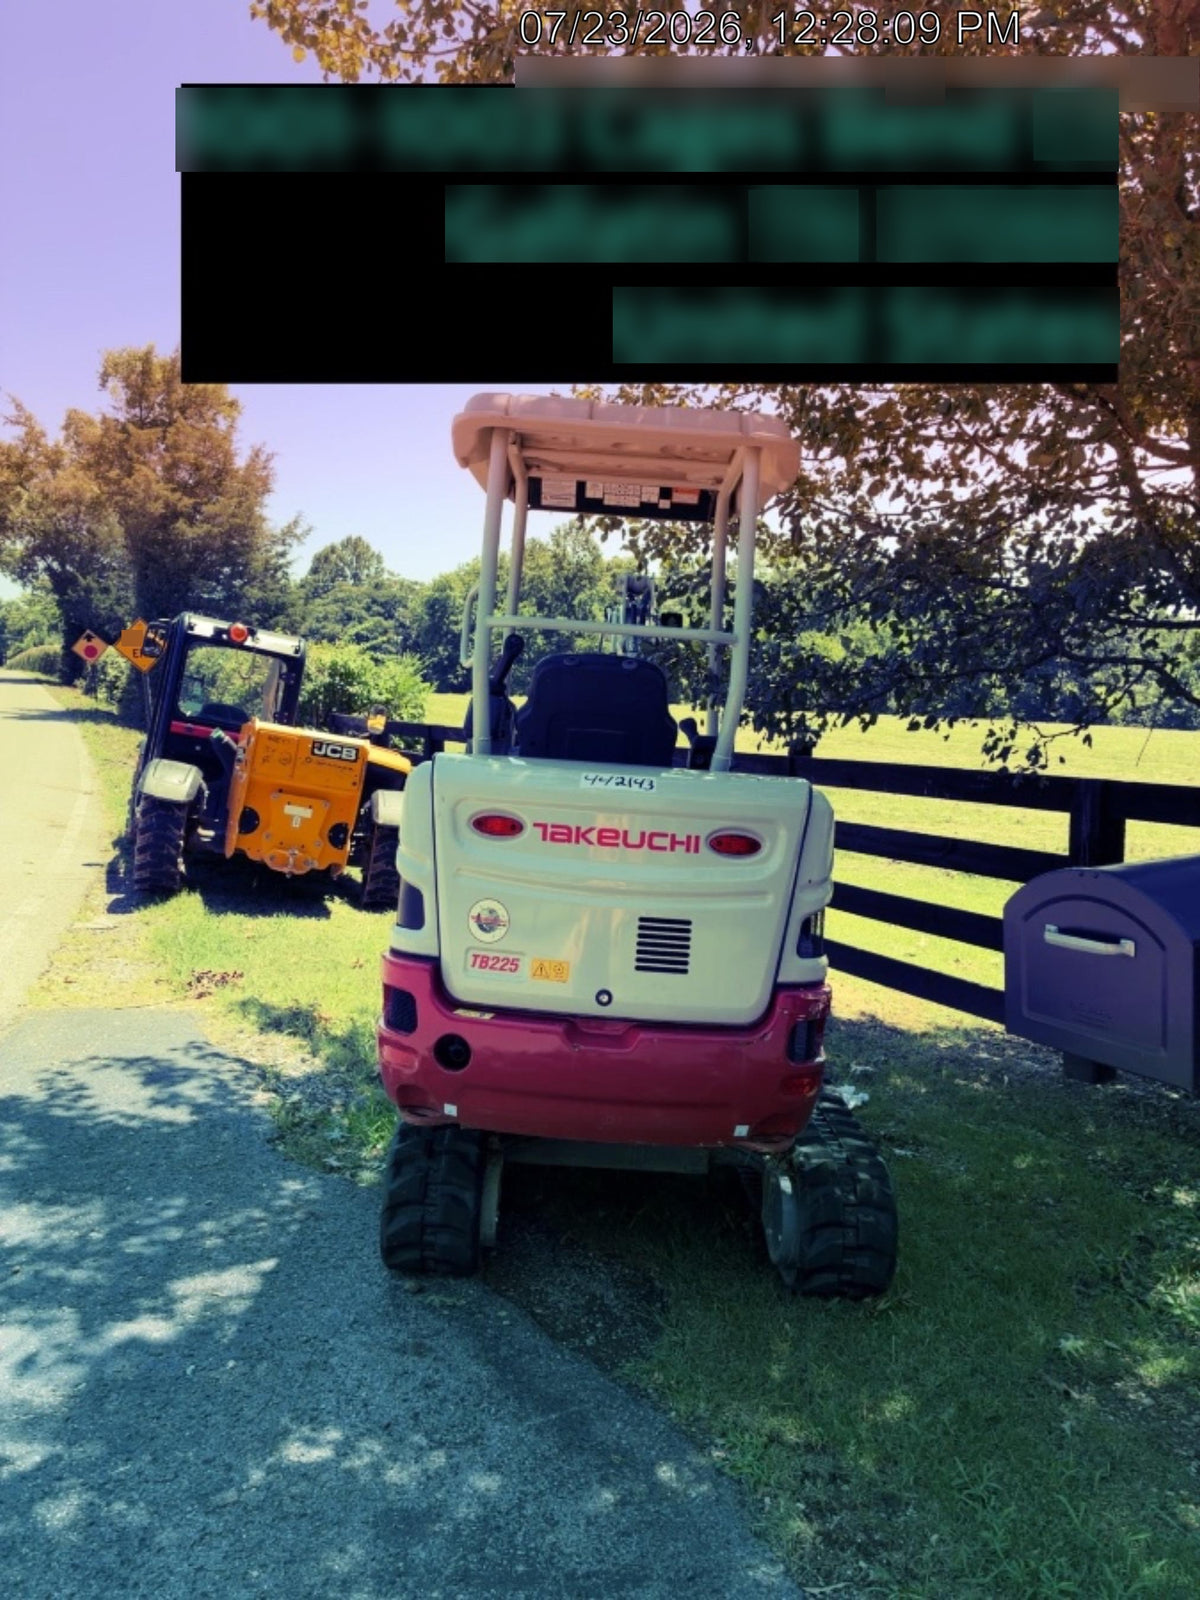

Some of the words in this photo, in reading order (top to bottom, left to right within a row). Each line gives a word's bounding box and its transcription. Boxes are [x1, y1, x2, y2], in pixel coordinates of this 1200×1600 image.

[313, 742, 357, 761] JCB
[584, 774, 655, 791] 442143
[533, 822, 701, 854] TAKEUCHI
[470, 953, 520, 973] TB225
